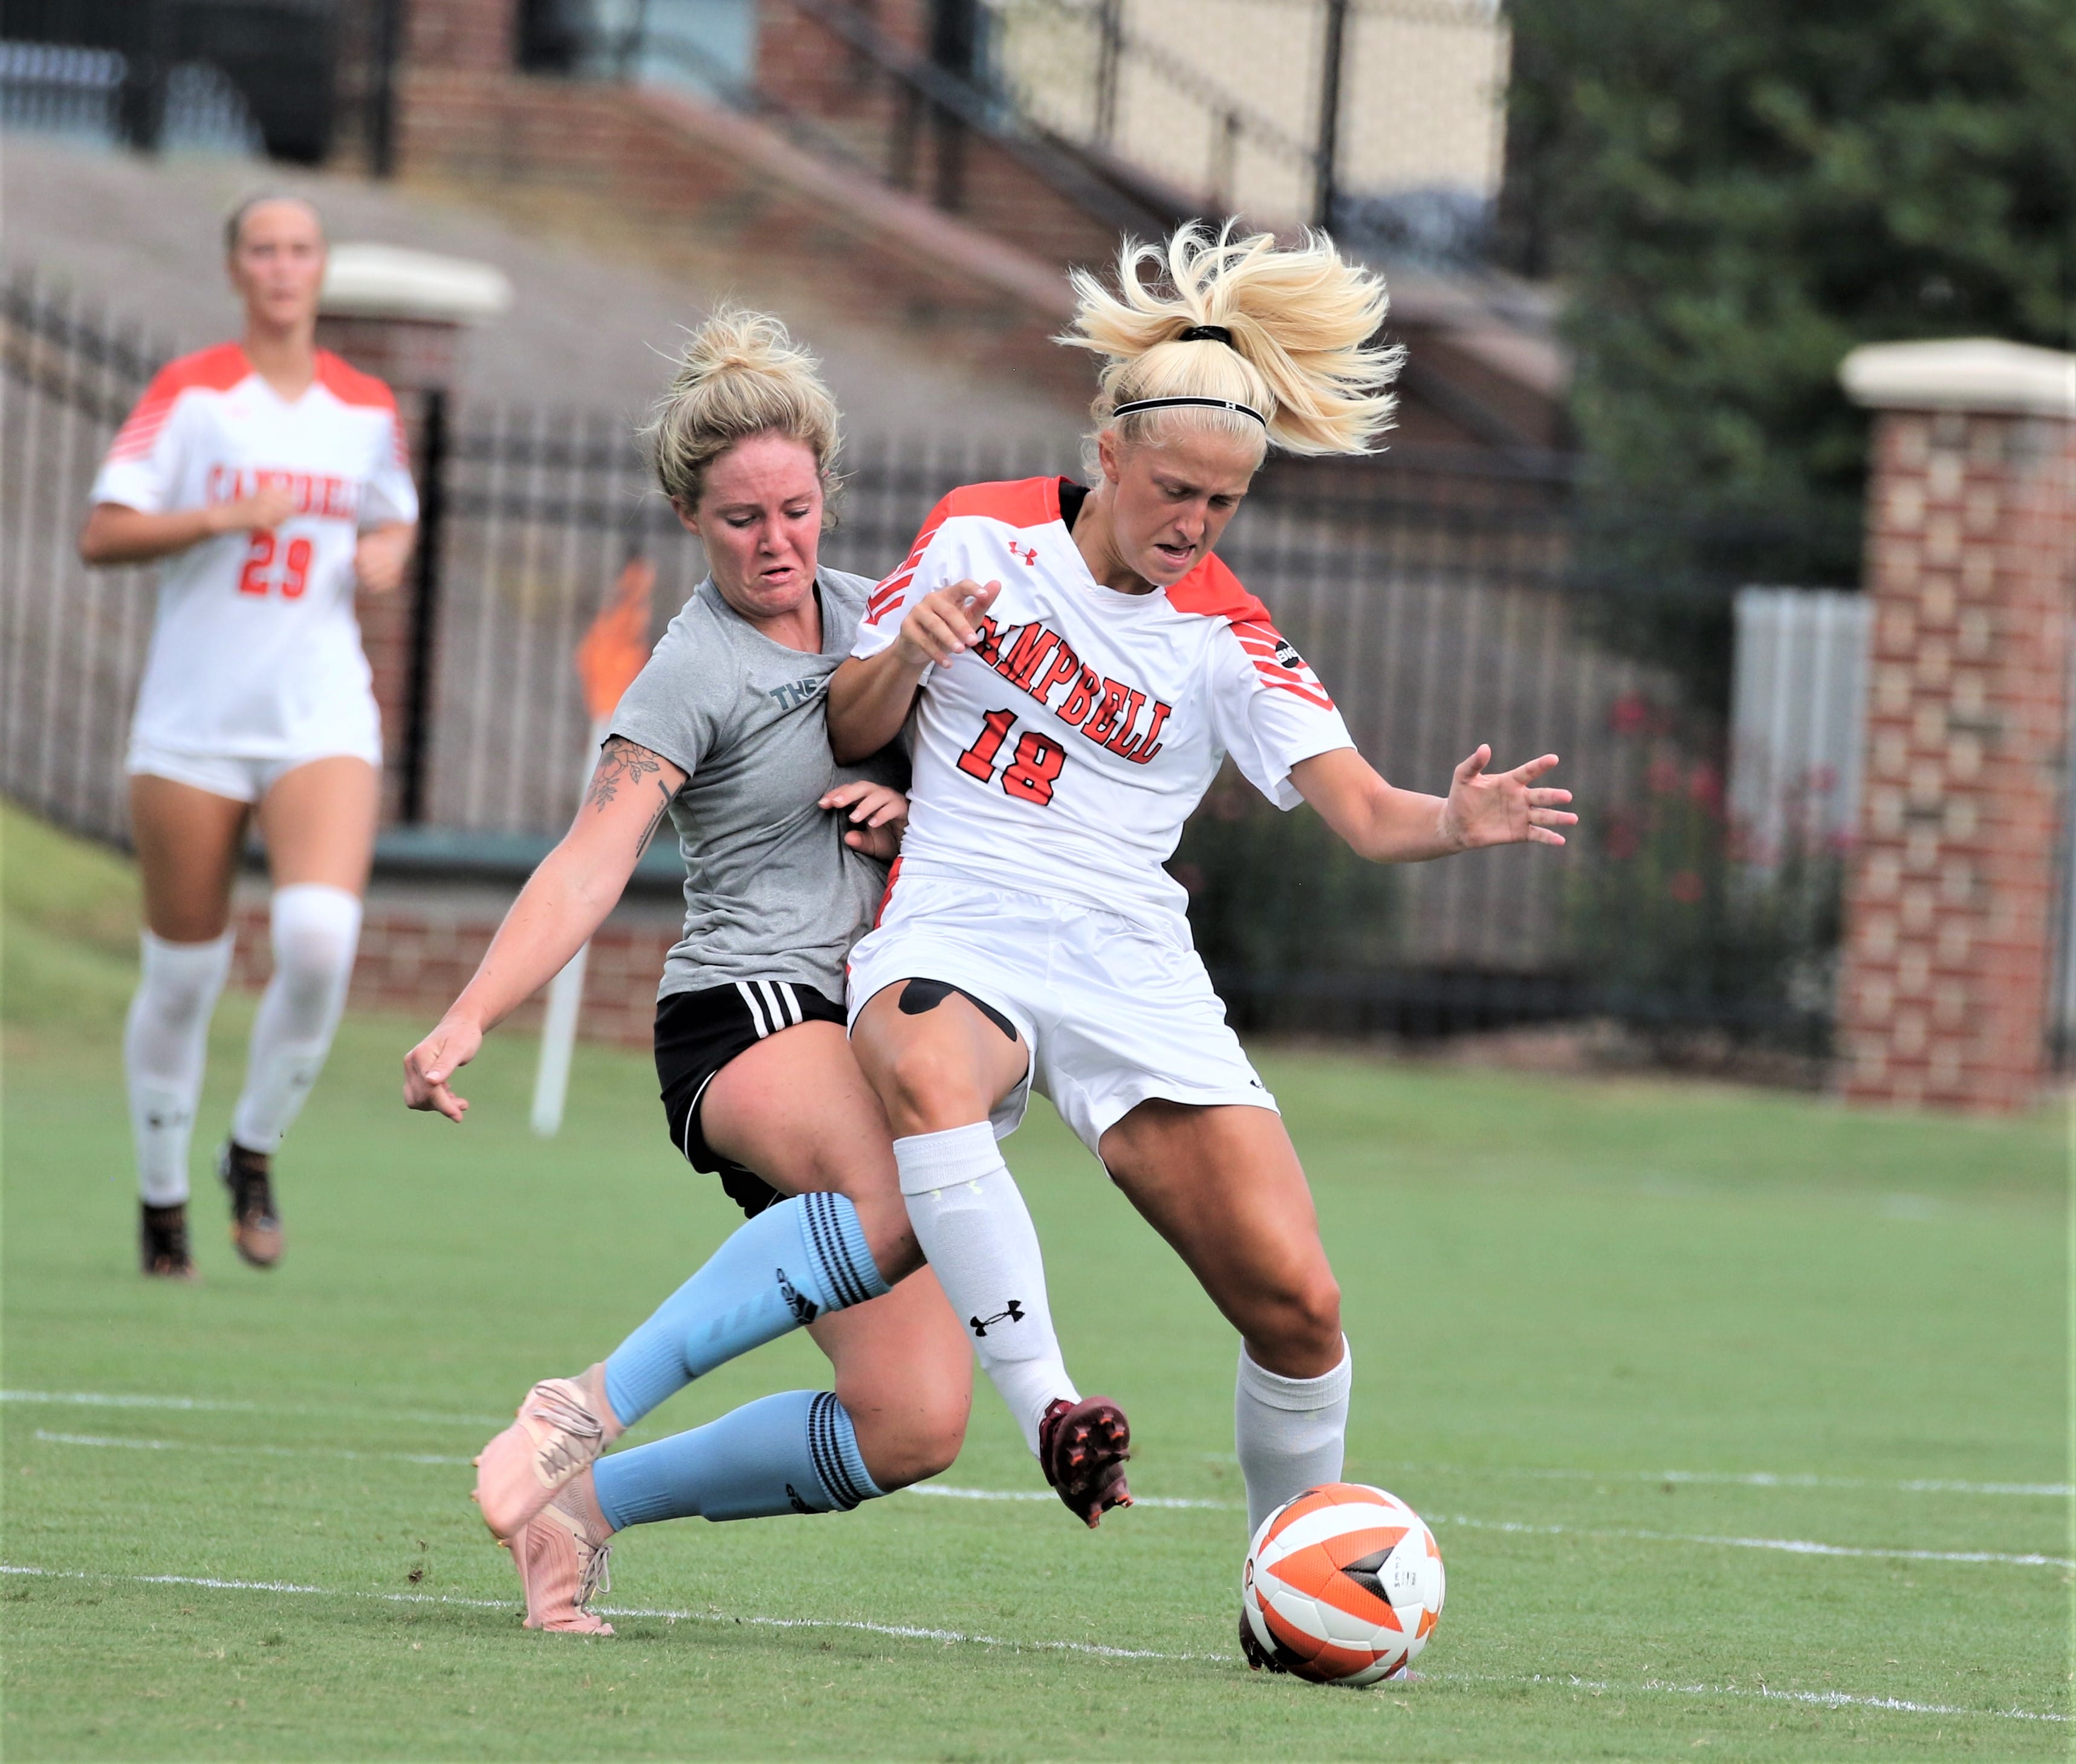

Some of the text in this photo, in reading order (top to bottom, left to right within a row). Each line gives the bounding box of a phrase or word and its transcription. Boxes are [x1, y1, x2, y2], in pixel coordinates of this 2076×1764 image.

[238, 527, 312, 598] 29
[769, 678, 817, 711] THE
[956, 708, 1068, 806] 18
[776, 1268, 815, 1325] adida
